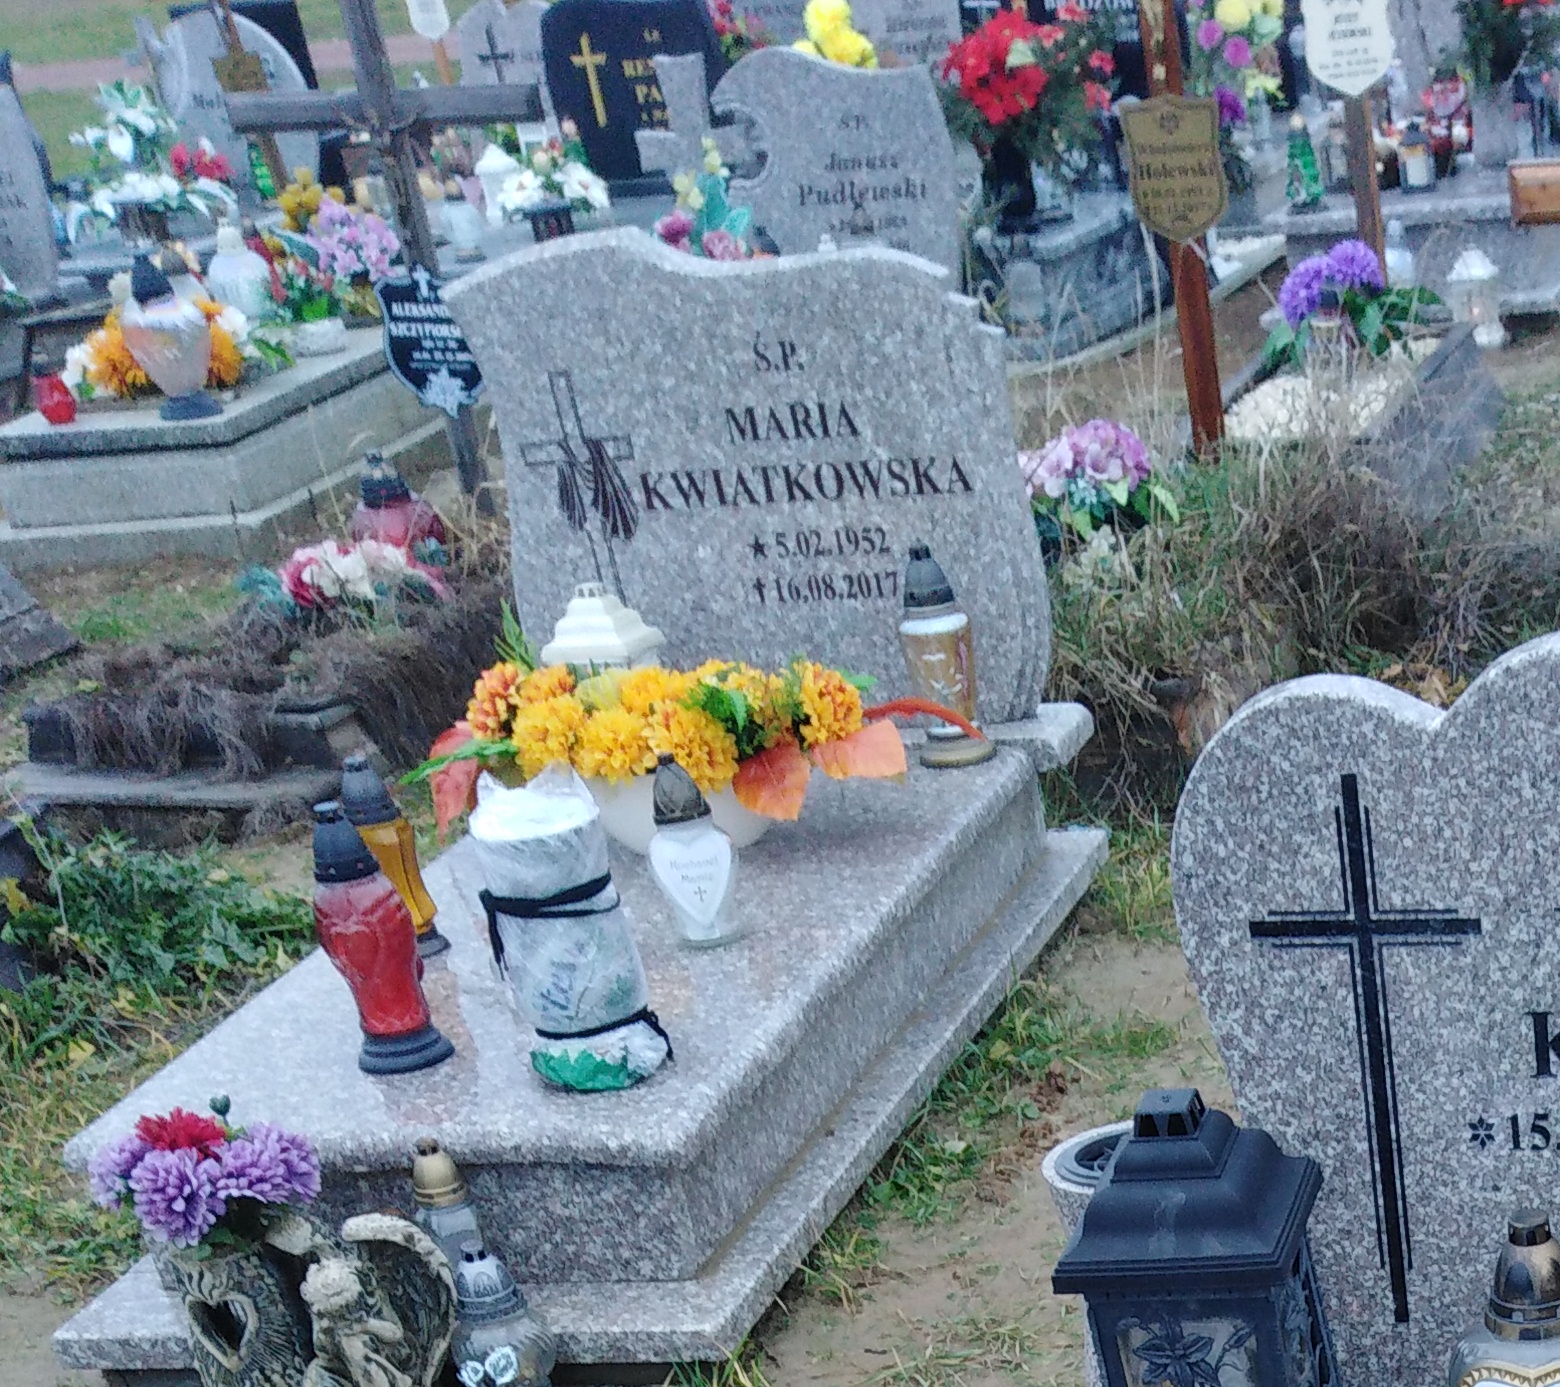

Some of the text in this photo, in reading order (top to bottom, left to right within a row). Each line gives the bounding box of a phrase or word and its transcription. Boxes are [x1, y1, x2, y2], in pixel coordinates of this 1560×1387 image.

[753, 331, 805, 372] Ś.P.
[725, 399, 861, 445] MARIA
[640, 455, 974, 512] KWIATKOWSKA
[775, 526, 892, 560] 5.02.1952
[774, 570, 899, 604] 16.08.2017
